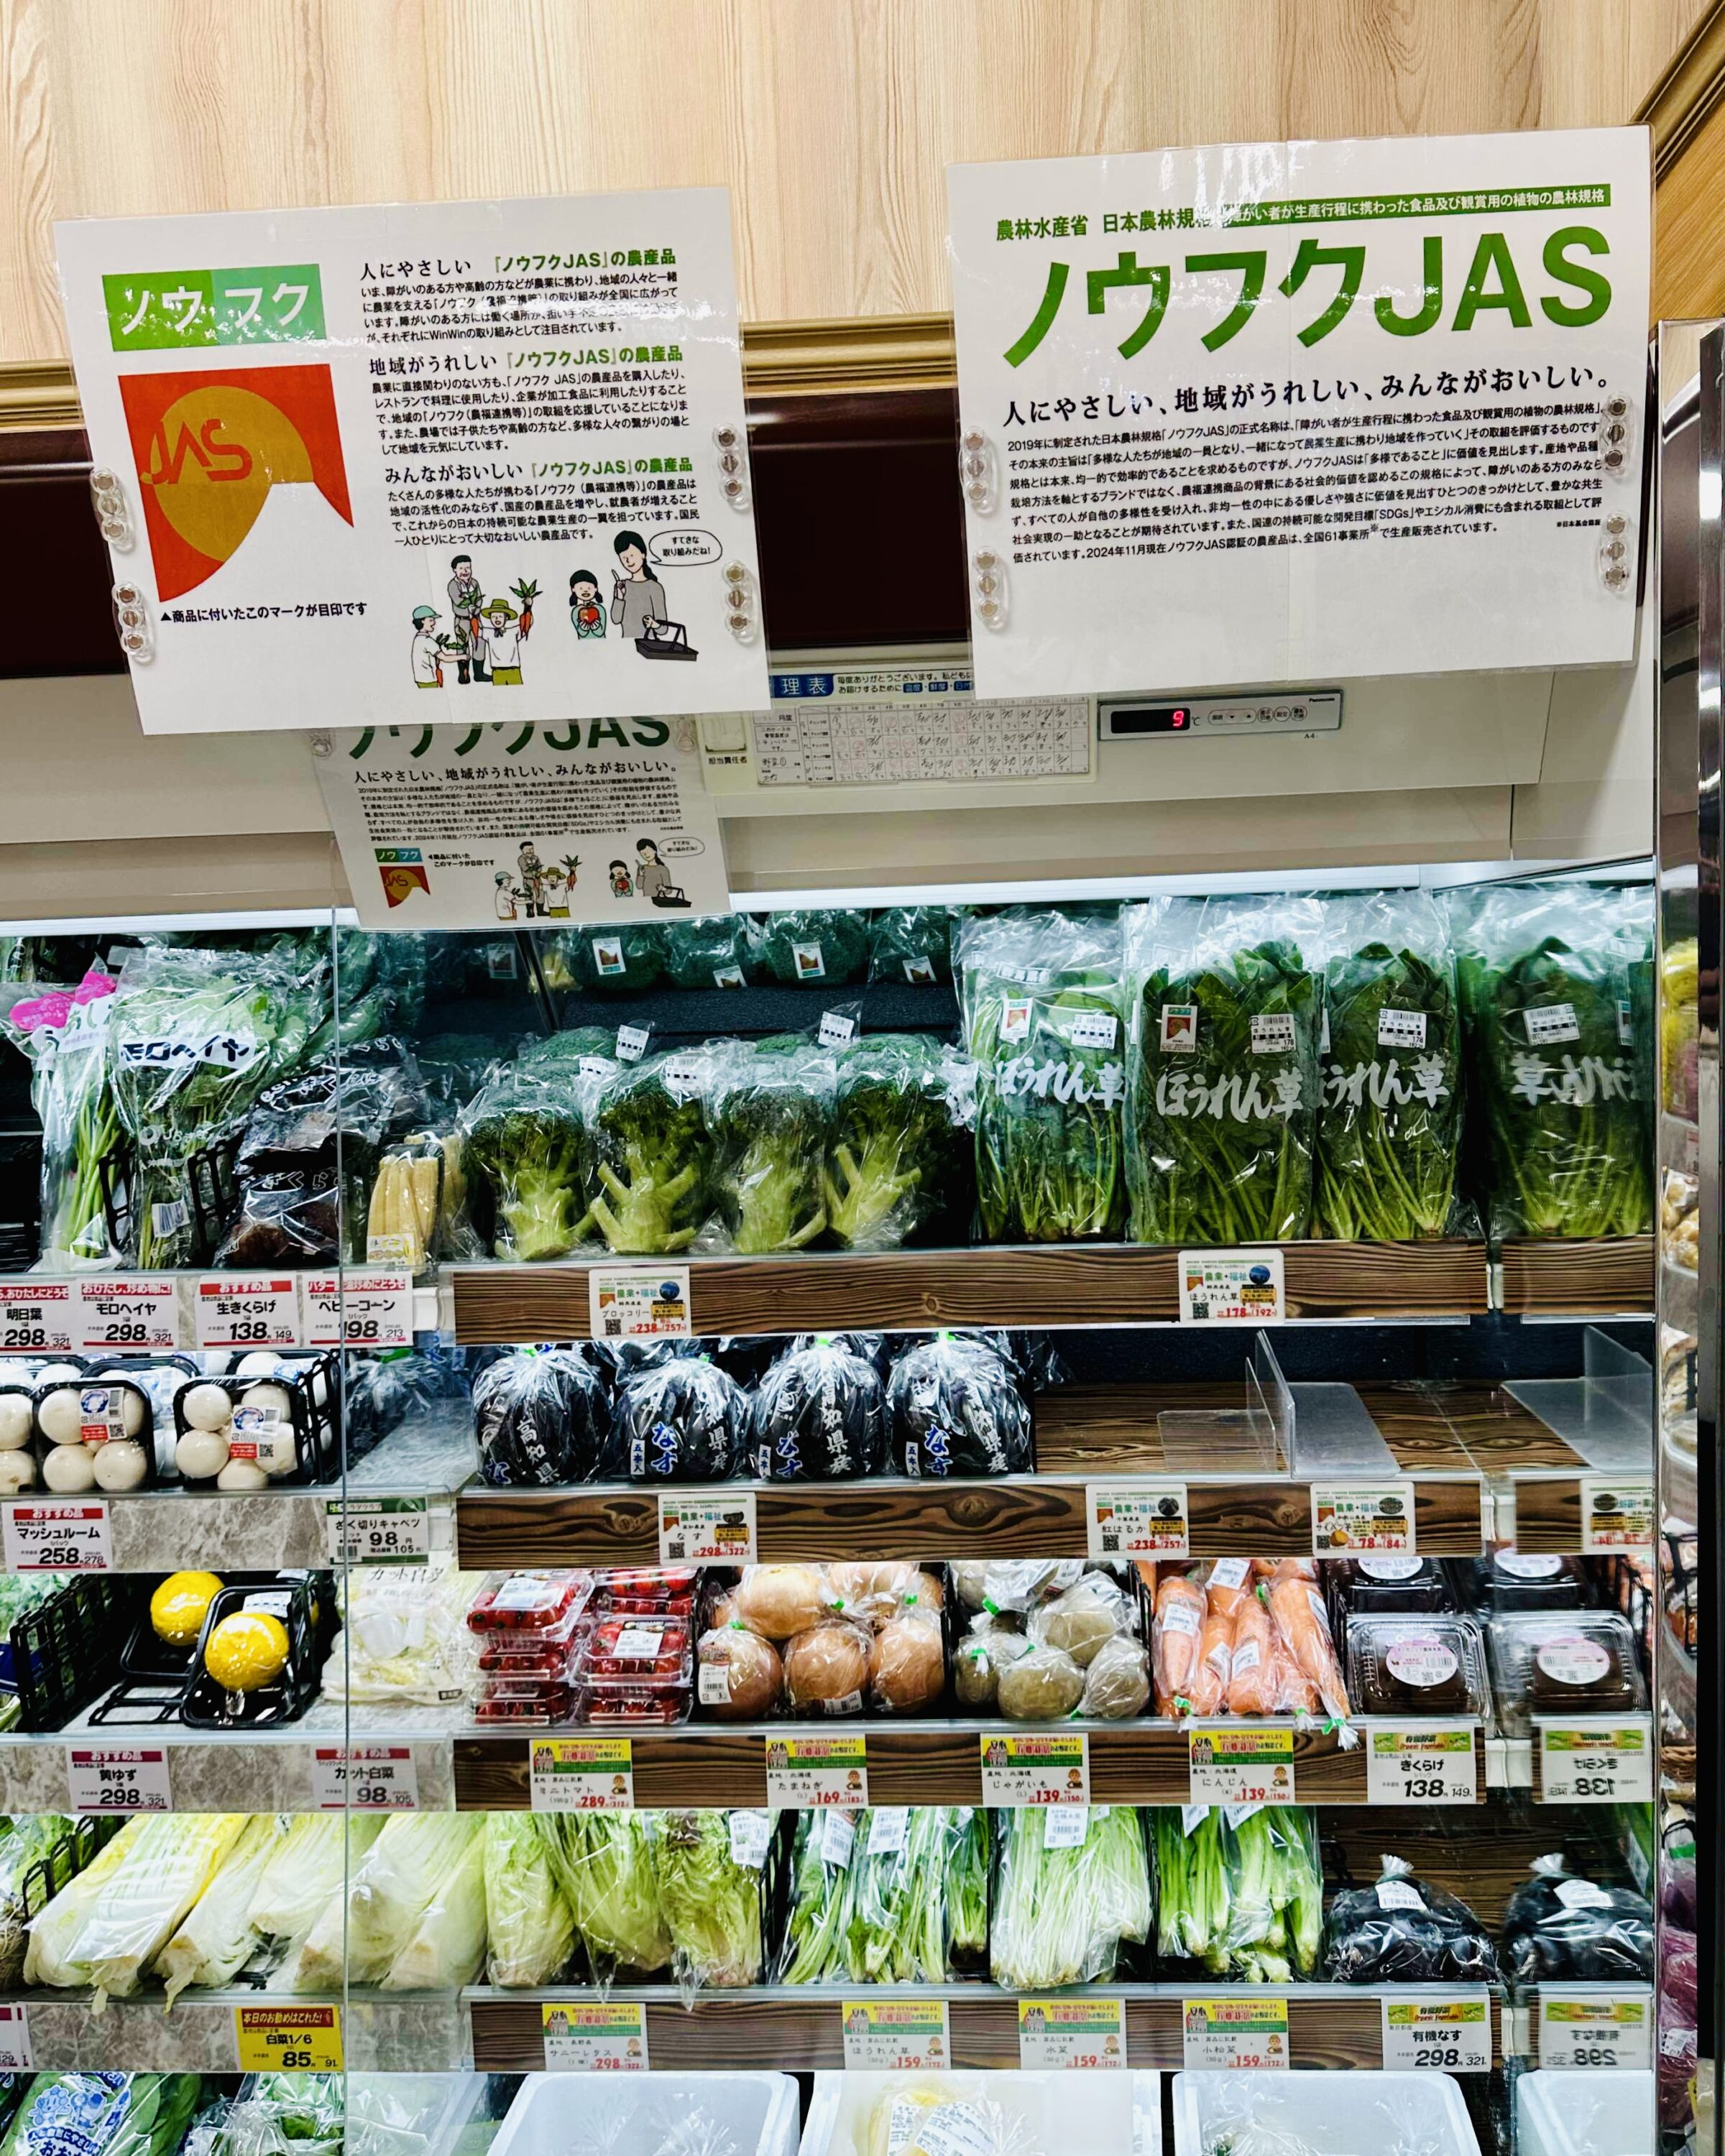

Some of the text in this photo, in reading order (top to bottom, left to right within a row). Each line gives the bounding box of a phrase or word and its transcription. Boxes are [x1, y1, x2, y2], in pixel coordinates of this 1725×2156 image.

[996, 214, 1088, 241] 農林水産省
[360, 248, 676, 281] 人にやさしい 『ノウフクJAS』の農産品
[1003, 226, 1612, 368] ノウフクJAS
[121, 282, 309, 336] ノウフク
[369, 345, 683, 376] 地域がうれしい 『ノウフクJAS』の農産品
[1003, 367, 1607, 428] 人にやさしい、地域がうれしい、みんながおいしい。
[141, 418, 253, 486] JAS
[382, 439, 509, 455] して地域を元気にしています。
[385, 457, 693, 484] みんながおいしい 『ノウフクJAS』の農産品
[671, 535, 699, 545] すてきな
[1172, 711, 1184, 727] 9
[354, 760, 676, 784] 人にやさしい、地域がうれしい、みんながおいしい。
[1156, 1069, 1304, 1123] ほうれん草
[219, 1281, 272, 1294] おすすめ品
[1190, 1293, 1239, 1302] ほうれん草
[96, 1303, 157, 1316] モロヘイヤ
[217, 1299, 276, 1315] 生きくらげ
[318, 1299, 395, 1312] ベビーコーン
[6, 1307, 43, 1321] 明日葉
[651, 1420, 678, 1475] なす
[924, 1423, 952, 1476] なす
[32, 1508, 84, 1519] おすすめ品
[17, 1526, 101, 1539] マッシュルーム
[369, 1531, 398, 1546] 98
[91, 1751, 143, 1761] おすすめ品
[1401, 1759, 1445, 1772] きくらげ
[99, 1769, 137, 1782] 黄ゆず
[335, 1766, 395, 1779] カット白菜
[778, 1782, 823, 1790] たまねぎ
[993, 1780, 1048, 1789] じゃがいも
[1202, 1778, 1248, 1787] にんじん
[1412, 2030, 1463, 2042] 有機なす
[852, 2046, 911, 2055] ほうれん草
[1045, 2045, 1069, 2054] 水菜
[1202, 2045, 1237, 2054] 小松菜
